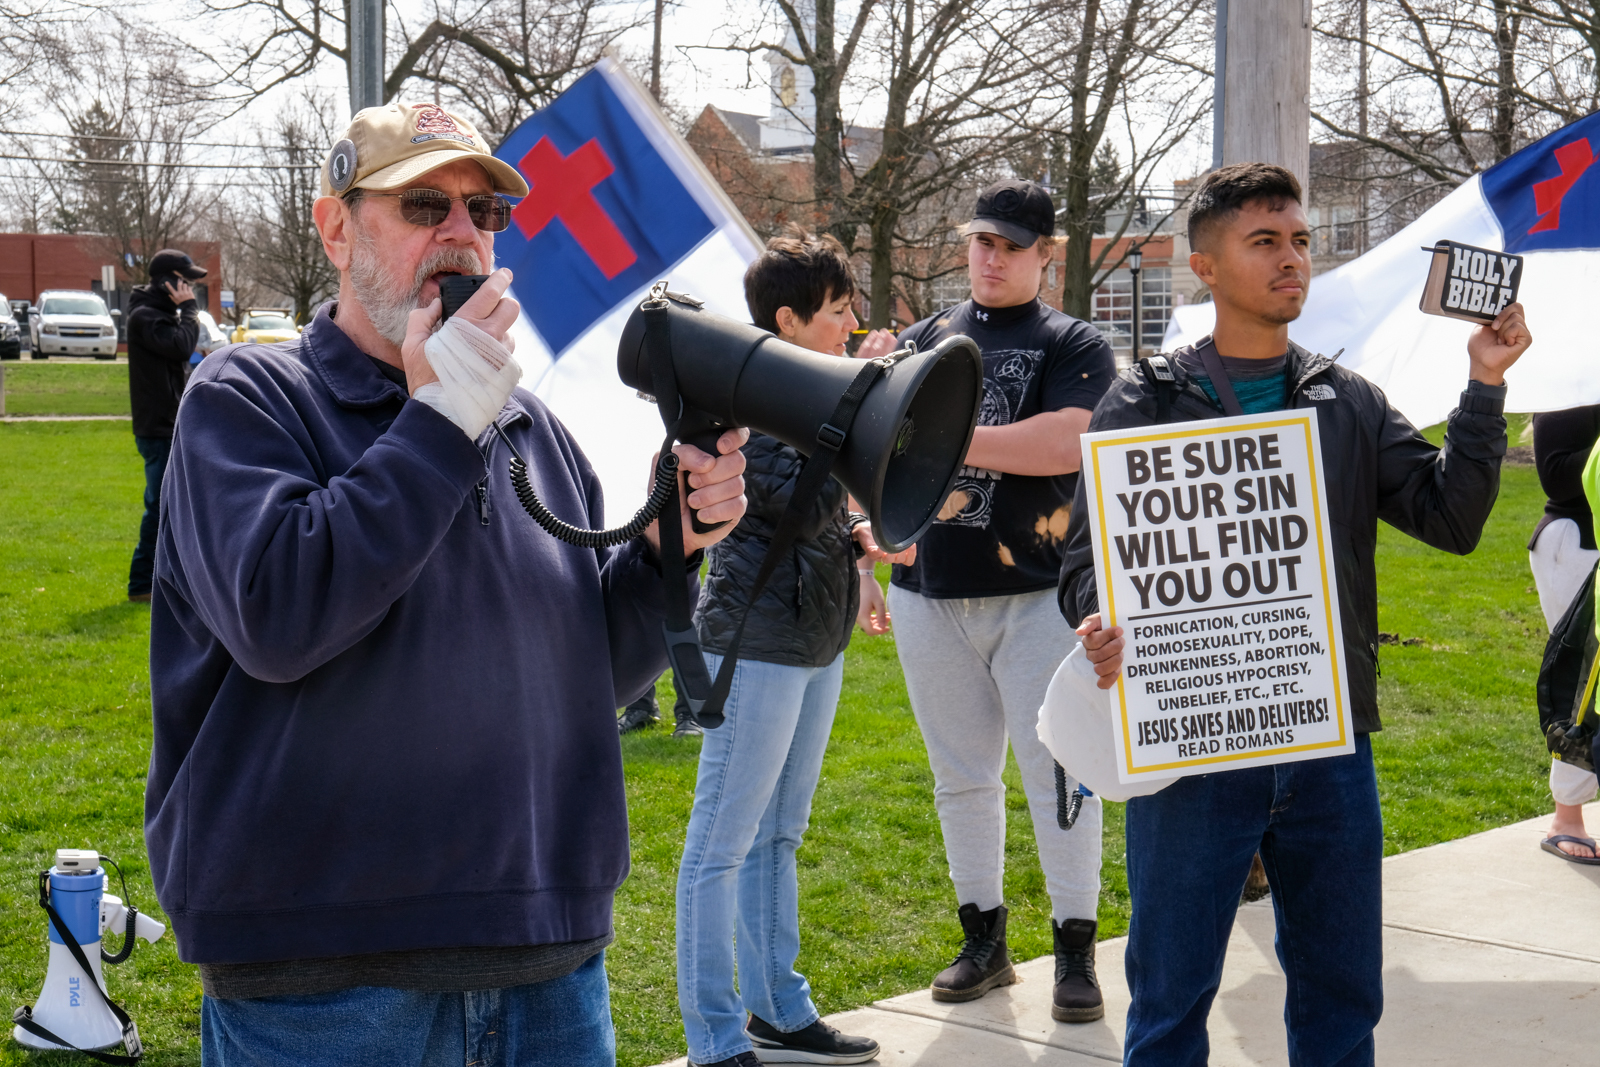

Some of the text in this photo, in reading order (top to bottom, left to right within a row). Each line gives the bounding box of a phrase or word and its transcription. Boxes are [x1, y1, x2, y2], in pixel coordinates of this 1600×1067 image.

[1451, 247, 1518, 287] HOLY
[1446, 278, 1513, 316] BIBLE
[1125, 433, 1282, 486] BE SURE
[1115, 472, 1298, 528] YOUR SIN
[1113, 514, 1309, 570] WILL FIND
[1129, 554, 1302, 610] YOU OUT
[1133, 606, 1311, 640] FORNICATION, CURSING,
[1135, 624, 1313, 659] HOMOSEXUALITY, DOPE,
[1126, 641, 1326, 679] DRUNKENNESS, ABORTION,
[1145, 661, 1312, 695] RELIGIOUS HYPOCRISY,
[1157, 681, 1304, 712] UNBELIEF, ETC., ETC.
[1137, 697, 1330, 747] JESUS SAVES AND DELIVERS!
[1177, 729, 1295, 758] READ ROMANS
[69, 977, 80, 1007] PYLE
